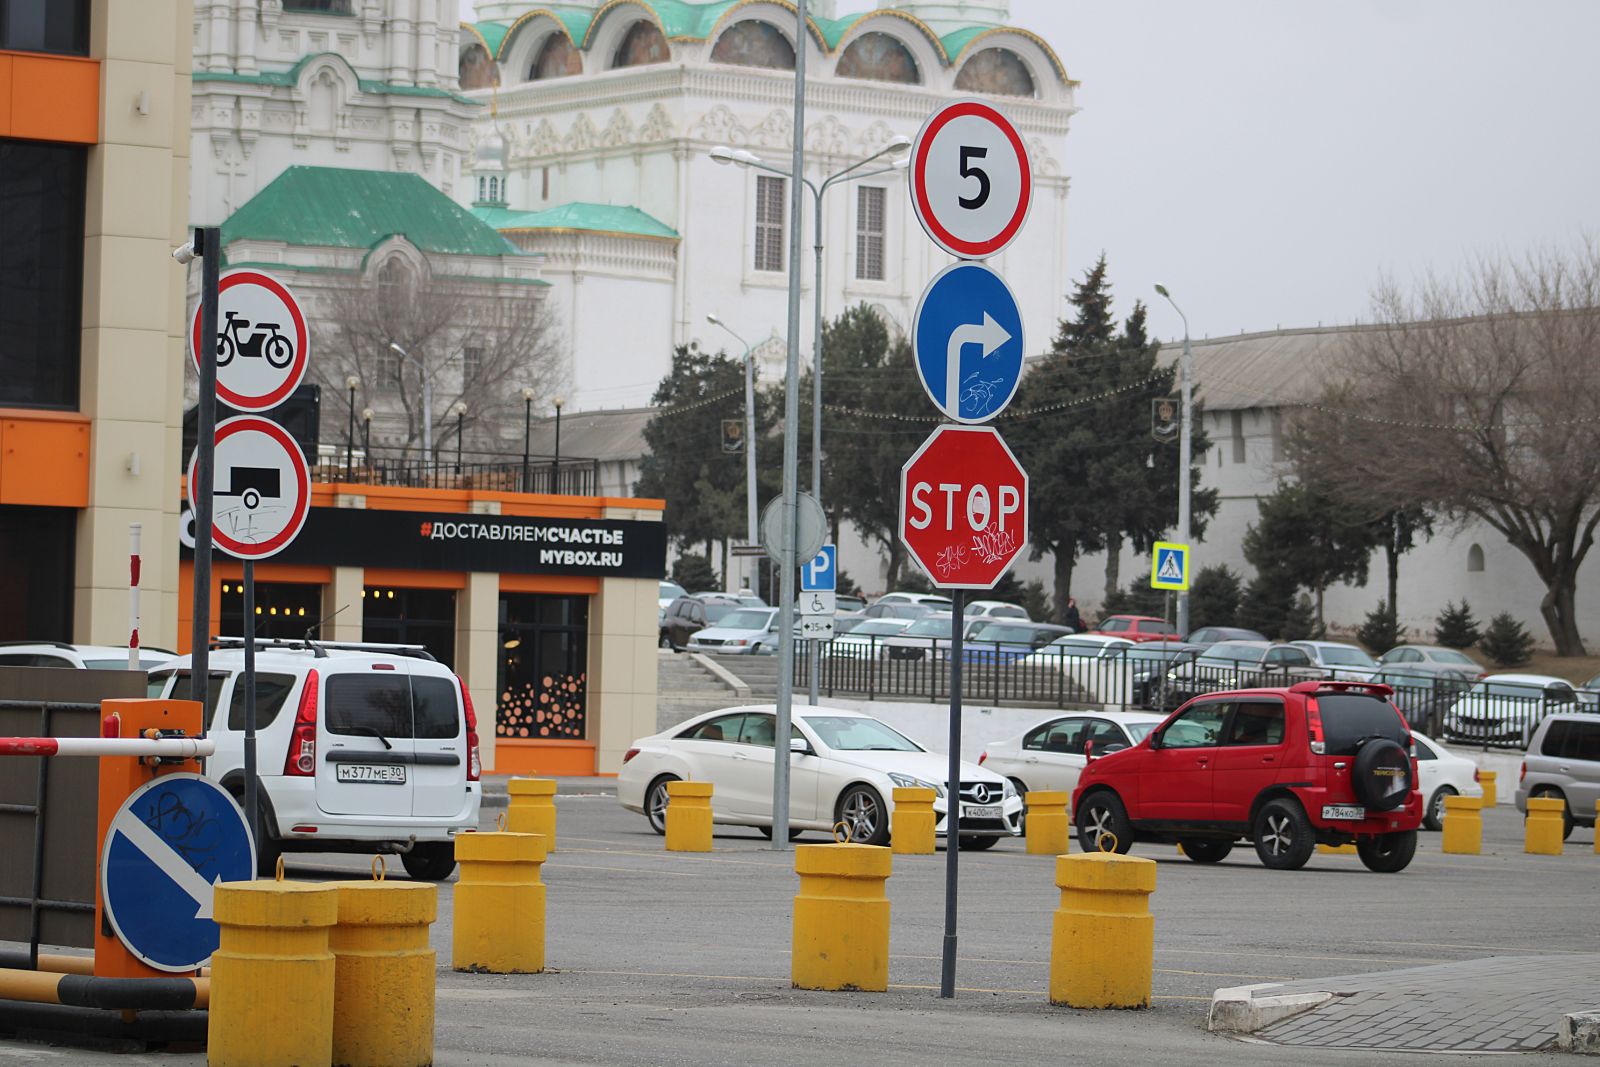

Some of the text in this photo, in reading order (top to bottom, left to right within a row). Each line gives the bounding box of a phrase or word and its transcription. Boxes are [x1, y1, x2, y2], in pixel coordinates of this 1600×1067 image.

[958, 145, 991, 210] 5
[909, 481, 1020, 531] STOP
[420, 521, 624, 545] #ДОСТАВЛЯЕМСЧАСТЬЕ
[540, 549, 623, 567] MYBOX.RU
[810, 550, 830, 586] P
